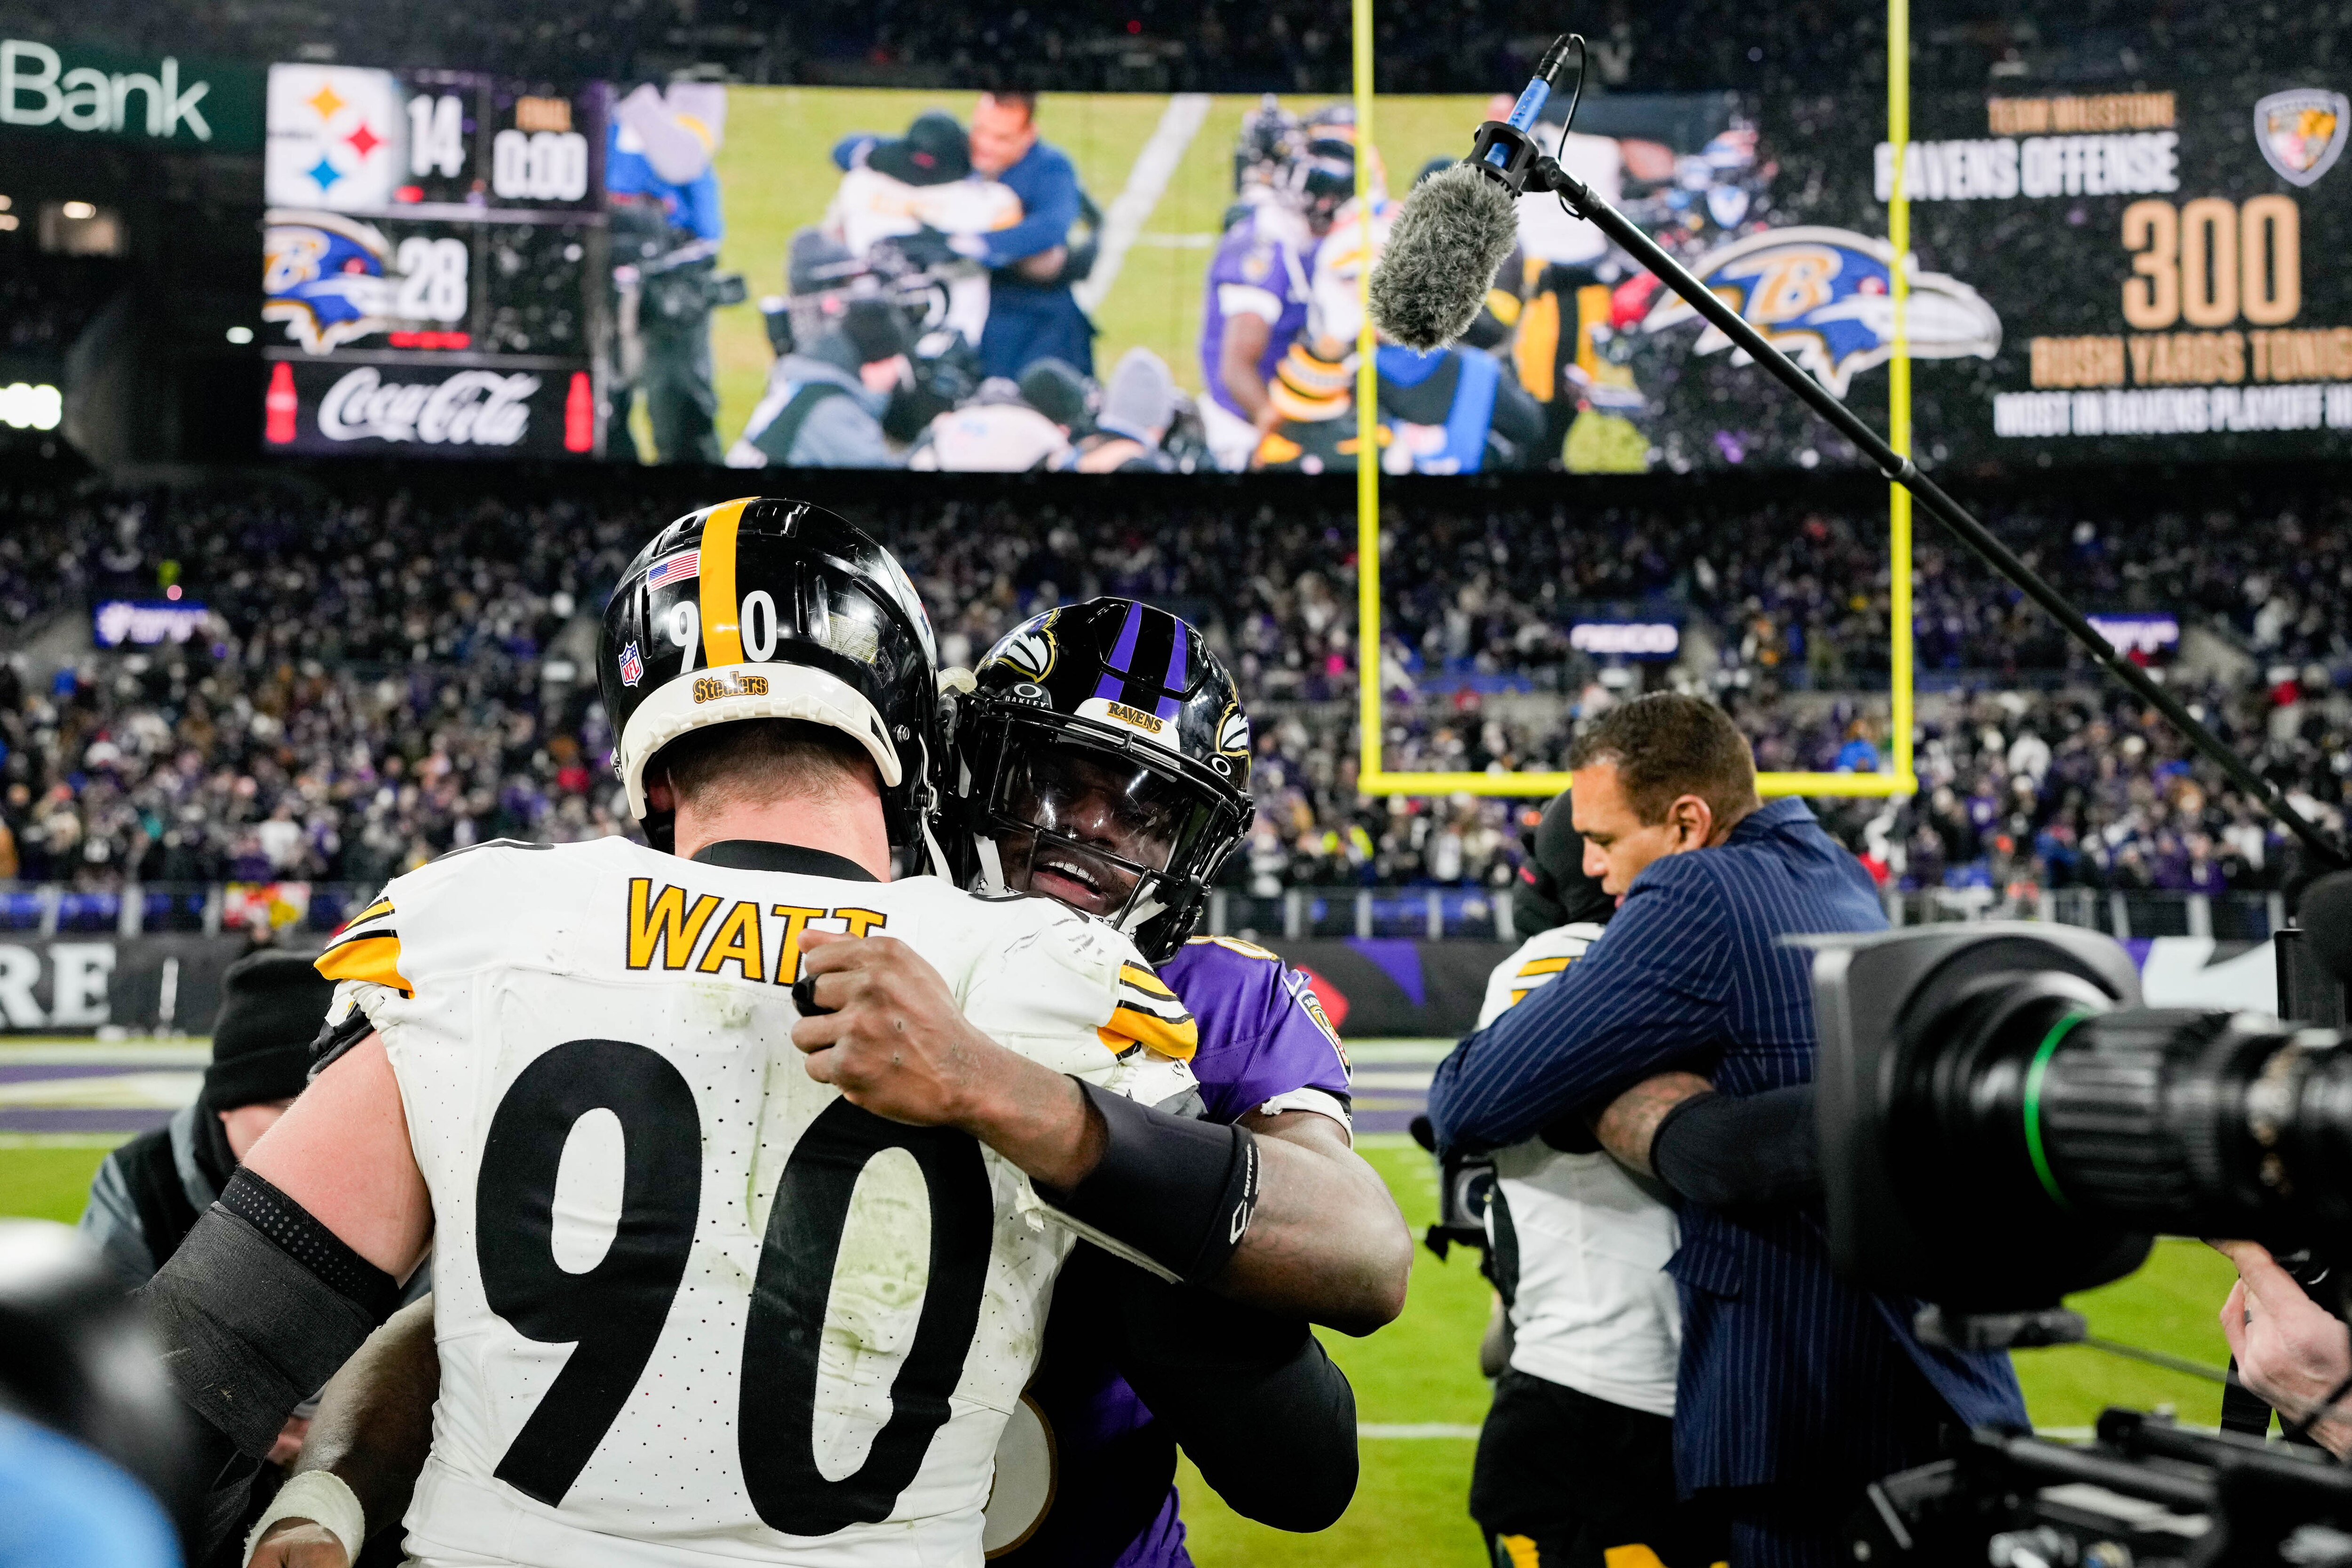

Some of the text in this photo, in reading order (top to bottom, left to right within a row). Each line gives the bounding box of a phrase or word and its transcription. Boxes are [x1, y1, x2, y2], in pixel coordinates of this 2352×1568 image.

[0, 40, 212, 141] Bank
[407, 95, 466, 178] 14
[493, 128, 588, 201] 0:00
[2022, 132, 2179, 198] OFFENSE
[397, 238, 467, 321] 28
[2122, 195, 2301, 329] 300
[623, 659, 639, 681] NFL
[693, 672, 768, 704] Steelers
[1107, 702, 1163, 734] RAVENS
[476, 1038, 994, 1536] 90
